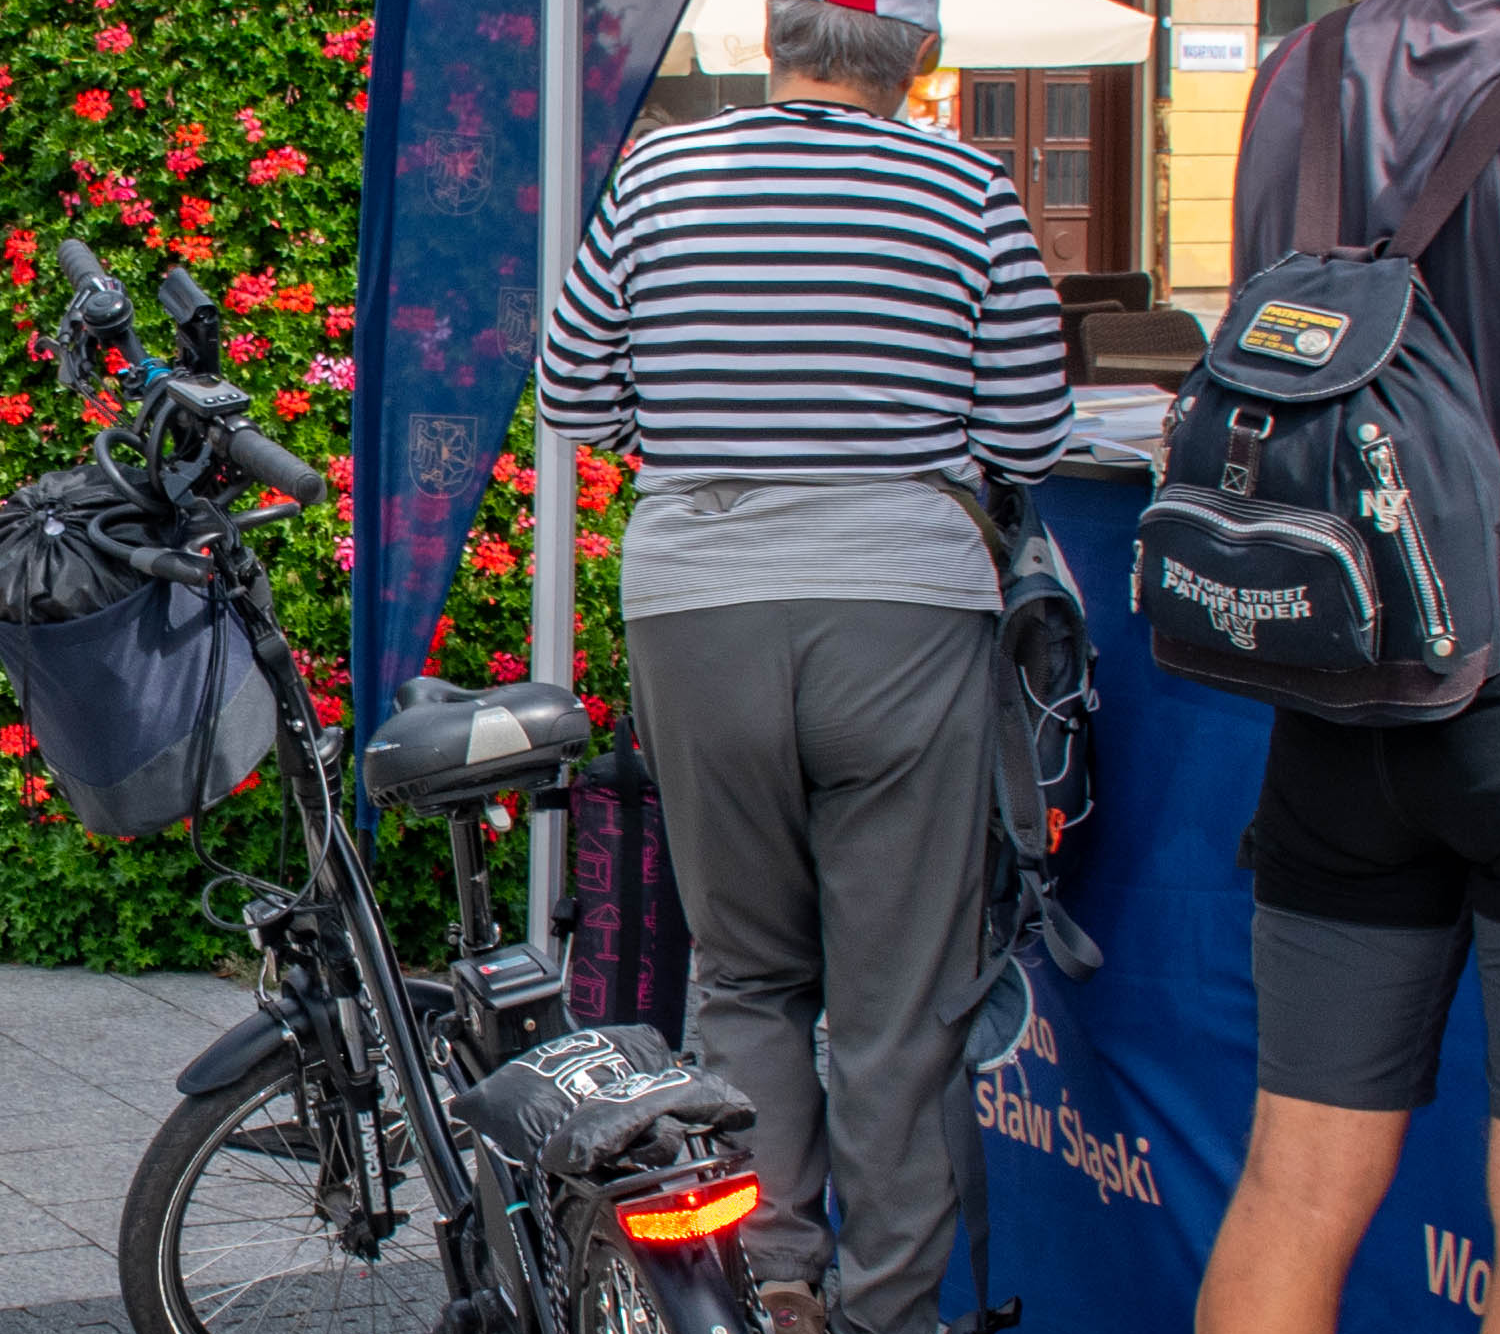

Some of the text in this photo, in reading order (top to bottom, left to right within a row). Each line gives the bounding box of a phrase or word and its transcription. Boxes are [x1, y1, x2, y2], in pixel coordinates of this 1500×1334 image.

[1161, 569, 1313, 620] PATHFINDER
[1162, 556, 1309, 604] NEW YORK STREET
[356, 1109, 381, 1178] CARVE
[1057, 1087, 1163, 1207] Śląski
